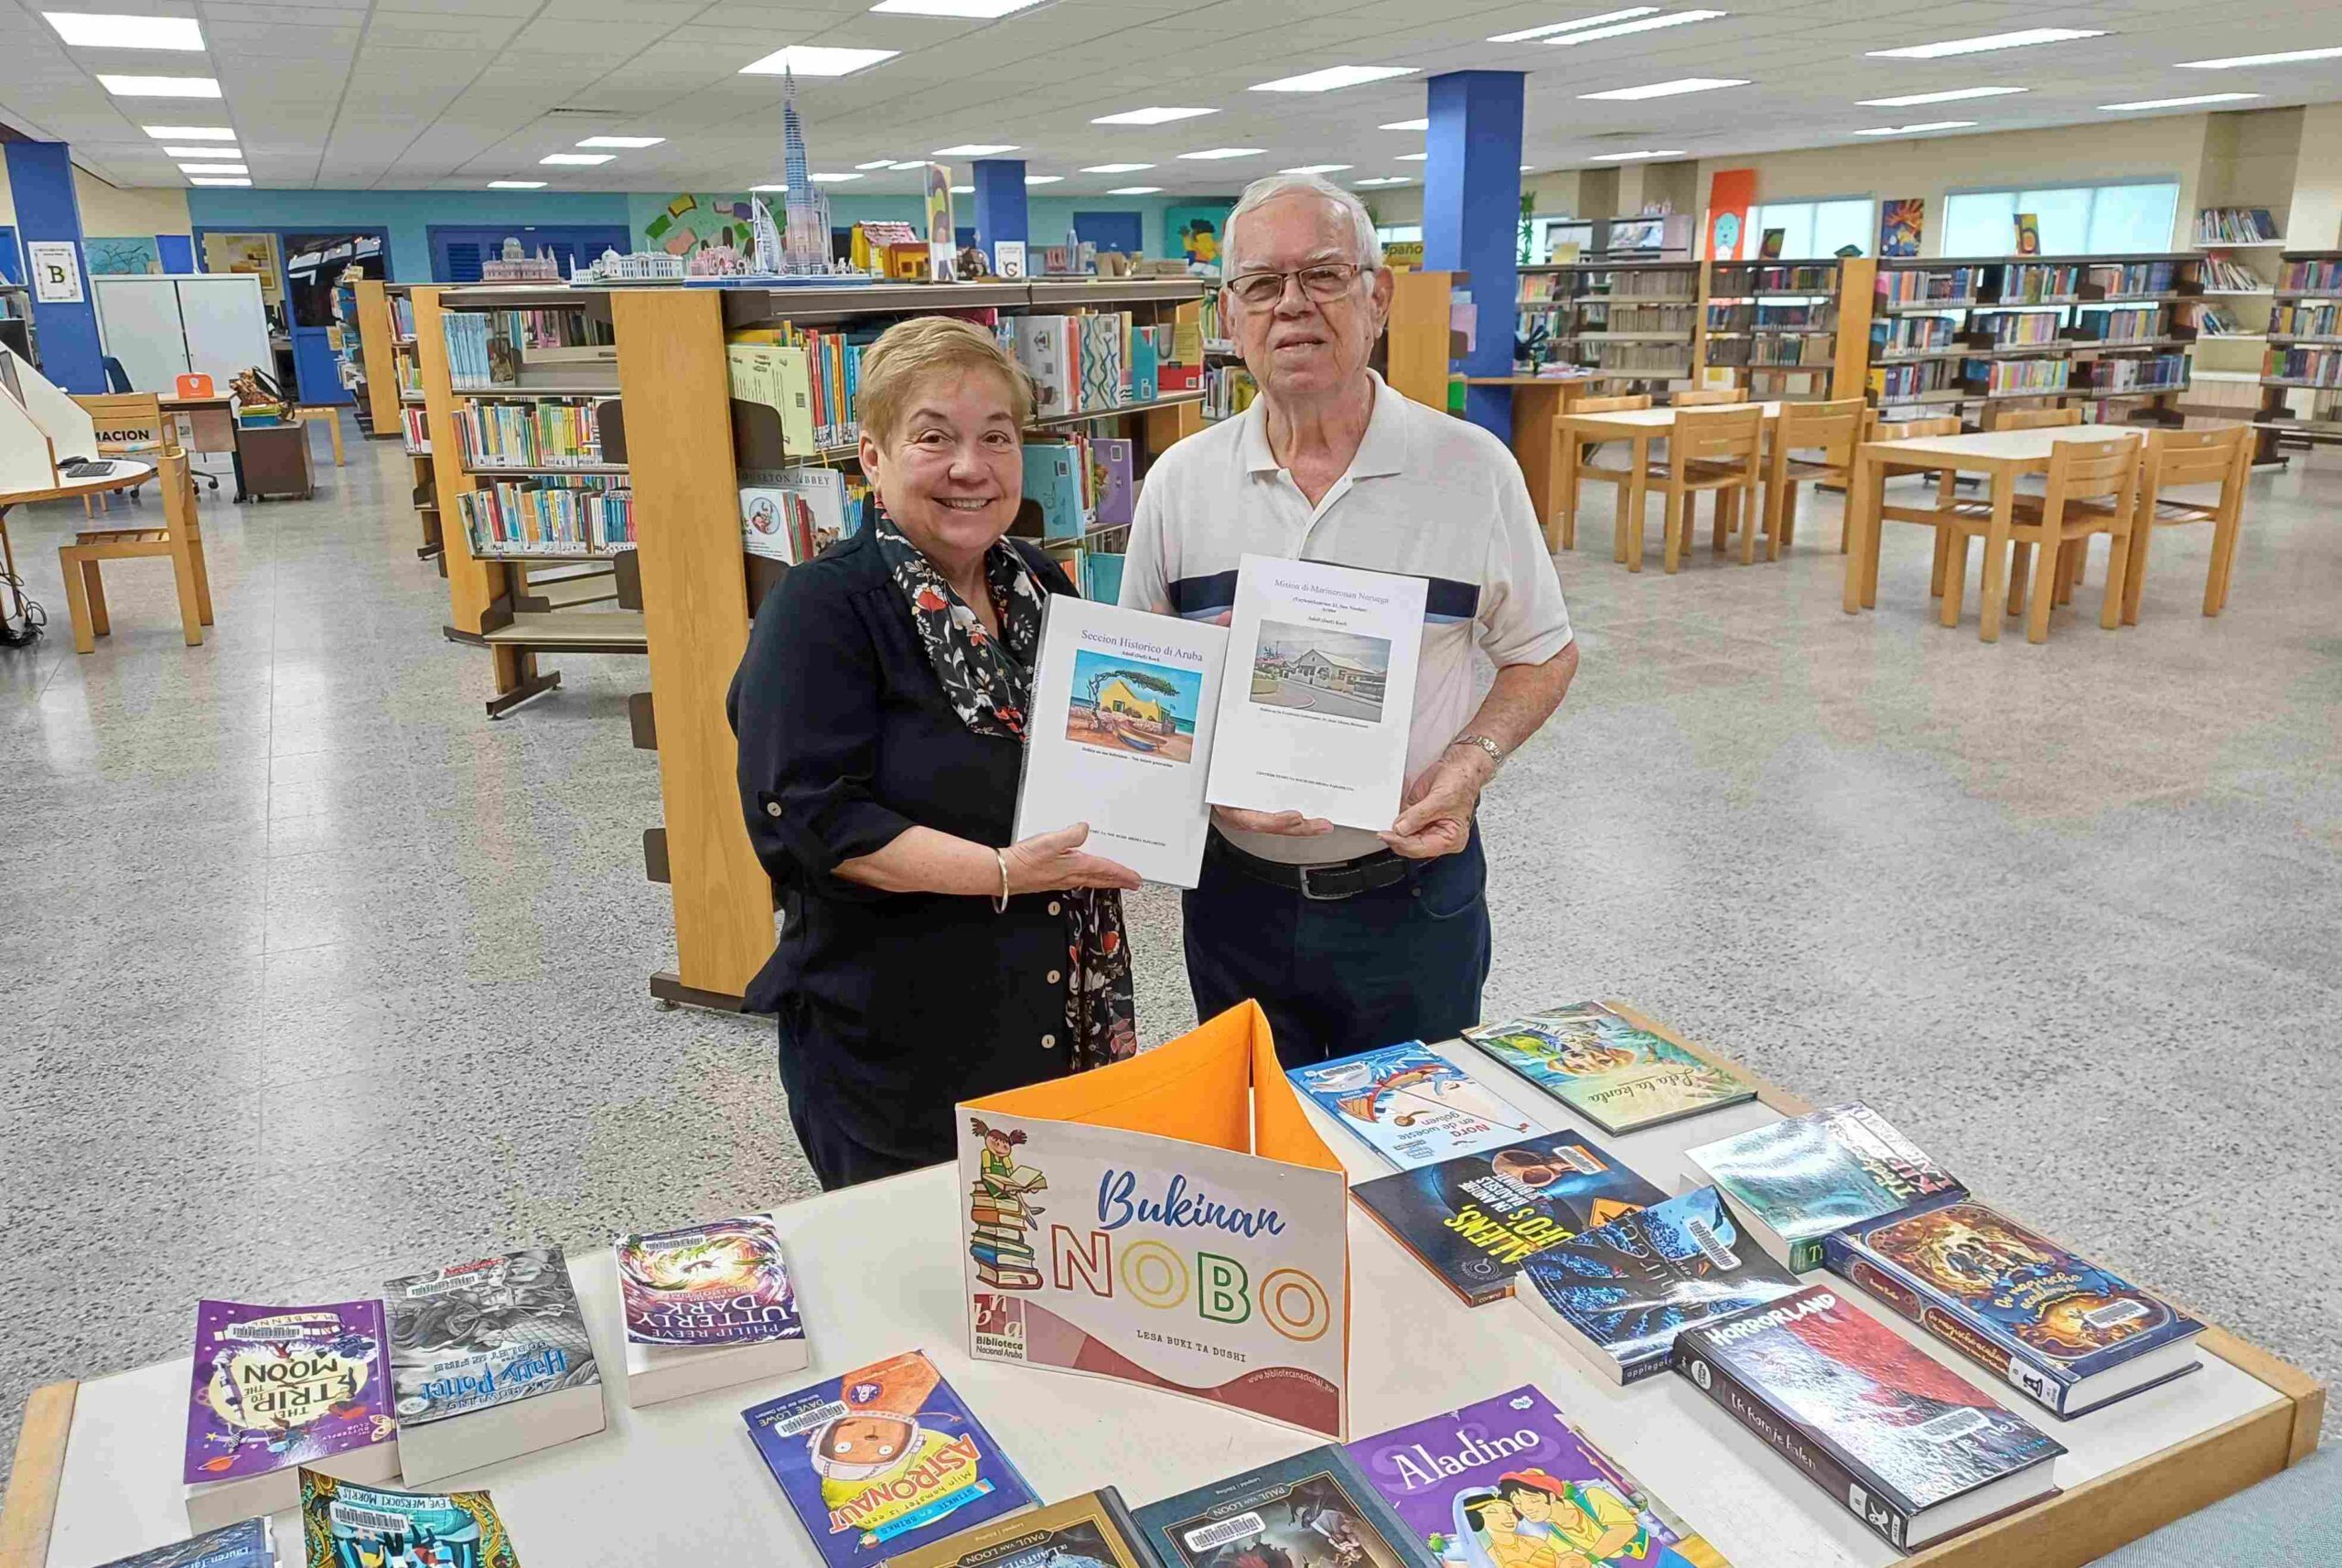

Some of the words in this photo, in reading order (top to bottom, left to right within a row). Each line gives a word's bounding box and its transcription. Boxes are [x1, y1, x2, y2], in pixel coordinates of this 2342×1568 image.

[47, 264, 65, 284] B
[1081, 628, 1117, 645] Seccion
[1120, 637, 1162, 654] Historico
[1164, 646, 1173, 656] di
[1175, 648, 1203, 661] Aruba
[1420, 1111, 1460, 1126] golven
[1441, 1122, 1456, 1131] de
[1460, 1117, 1474, 1125] en
[1398, 1127, 1439, 1141] woeste
[1450, 1123, 1490, 1137] Nora
[1098, 1169, 1286, 1238] Bukinan
[1051, 1224, 1332, 1342] NOBO
[657, 1294, 760, 1315] DARK
[252, 1315, 301, 1327] BENN
[634, 1305, 791, 1328] UTTERLY
[1704, 1294, 1836, 1347] HORRORLAND
[651, 1328, 707, 1337] REEVE
[716, 1324, 778, 1337] PHILIP
[490, 1340, 547, 1359] GOBLET
[976, 1336, 1024, 1350] Biblioteca
[1137, 1329, 1163, 1343] LESA
[1166, 1336, 1192, 1350] BUKI
[1196, 1342, 1209, 1354] TA
[1212, 1347, 1247, 1364] DUSHI
[976, 1345, 1004, 1356] Nacional
[1004, 1348, 1023, 1359] Aruba
[243, 1358, 338, 1384] MOON
[433, 1358, 469, 1373] FIRE
[500, 1348, 567, 1384] Harry
[419, 1363, 496, 1400] Potter
[1248, 1370, 1336, 1394] www.bibliotecanacional.aw
[242, 1385, 263, 1396] THE
[251, 1393, 264, 1402] TO
[253, 1383, 335, 1412] TRIP
[446, 1386, 521, 1411] ROWLING
[279, 1406, 308, 1418] THE
[795, 1399, 824, 1413] DAVE
[757, 1410, 791, 1427] LOWE
[1731, 1392, 1746, 1412] Ik
[1747, 1406, 1772, 1434] kom
[1771, 1428, 1785, 1444] je
[320, 1425, 371, 1441] BUTTERFLY
[1391, 1425, 1540, 1490] Aladino
[829, 1433, 981, 1534] ASTRONAUT
[948, 1470, 972, 1487] Mijn
[343, 1487, 377, 1504] MORRIS
[903, 1486, 946, 1511] hamster
[937, 1487, 974, 1511] STINKIE
[1258, 1487, 1285, 1499] PAUL
[381, 1496, 424, 1508] WERSOCKI
[429, 1499, 446, 1508] EVE
[1212, 1500, 1243, 1516] LOON
[862, 1513, 884, 1526] een
[888, 1508, 899, 1518] is
[879, 1515, 918, 1535] BRINKS
[1015, 1532, 1045, 1546] PAUL
[210, 1547, 249, 1563] Lauren
[965, 1548, 998, 1563] LOON
